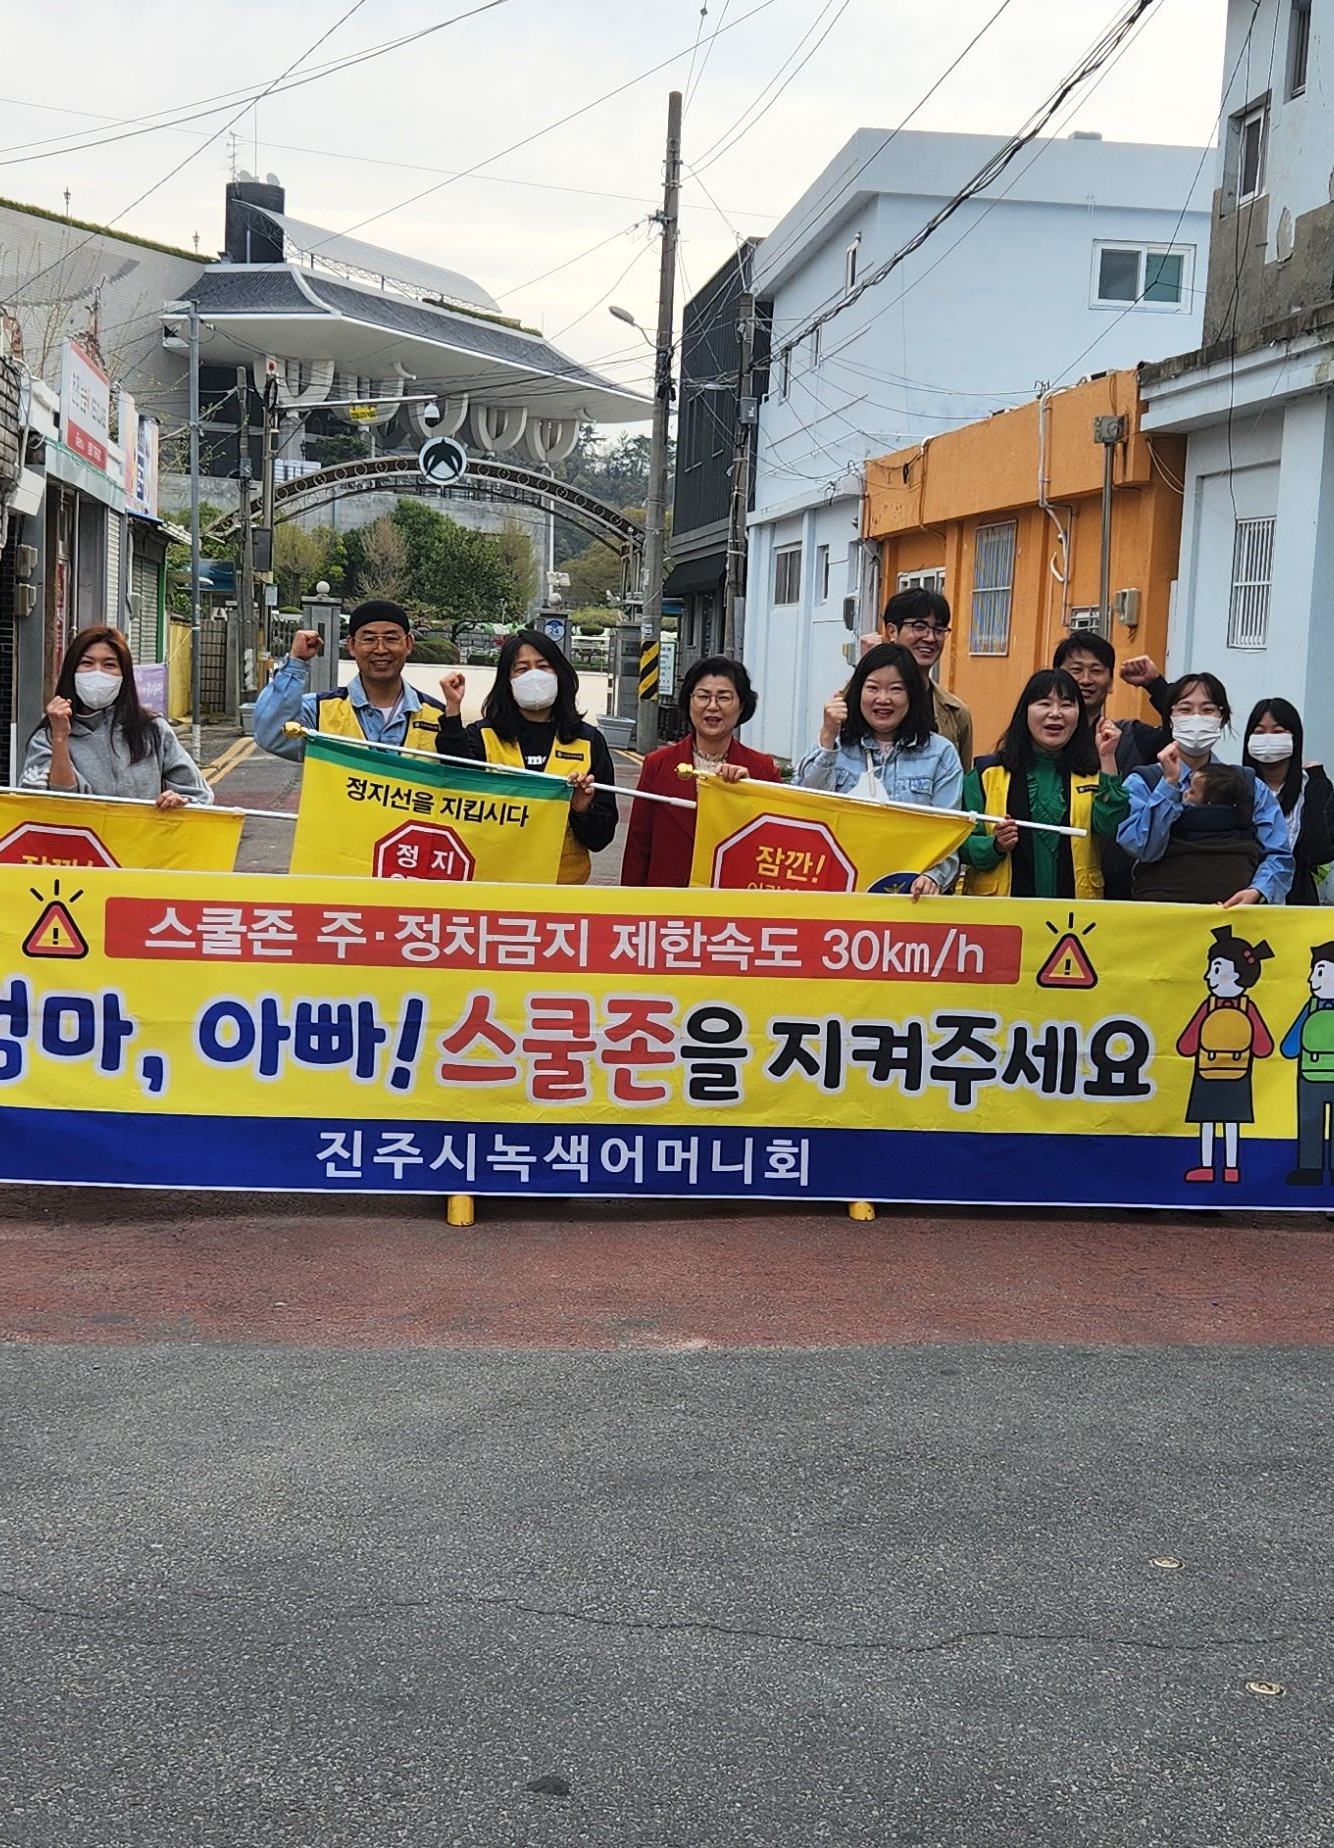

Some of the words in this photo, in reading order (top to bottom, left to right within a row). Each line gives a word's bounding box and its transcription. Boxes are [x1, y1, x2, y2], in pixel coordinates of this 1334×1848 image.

[345, 776, 435, 815] 정지선을
[440, 795, 529, 827] 지킵시다
[755, 845, 827, 884] 잠깐!
[144, 906, 299, 957] 스쿨존
[609, 919, 803, 971] 제한속도
[820, 927, 985, 978] 30km/h
[197, 996, 425, 1092] 아빠!
[439, 993, 750, 1102] 스쿨존을
[766, 1014, 1152, 1107] 지켜주세요
[315, 1129, 811, 1187] 진주시녹색어머니회
